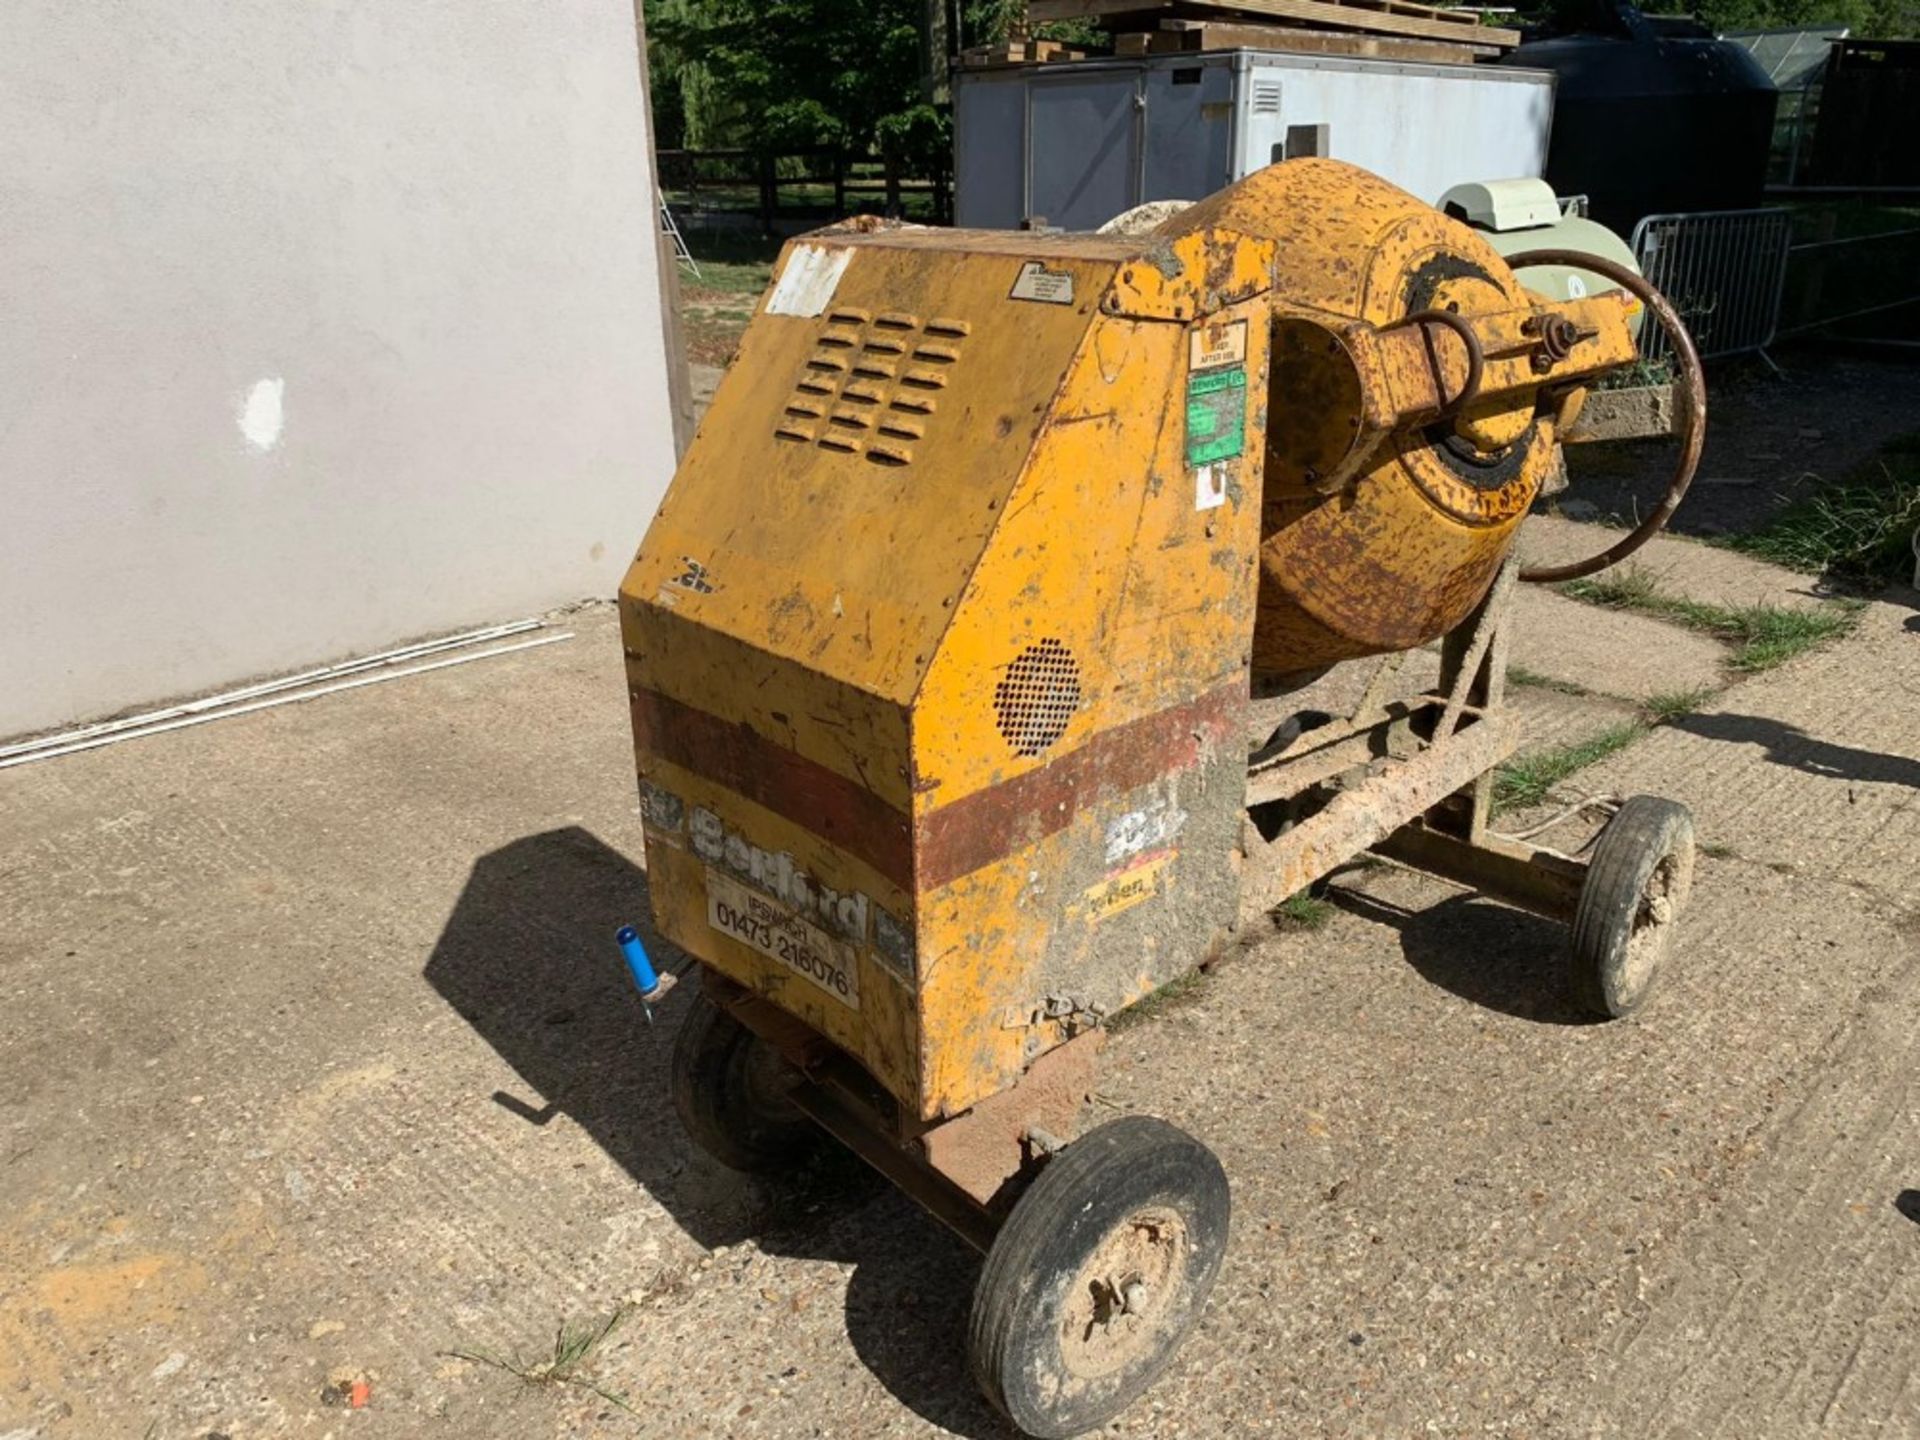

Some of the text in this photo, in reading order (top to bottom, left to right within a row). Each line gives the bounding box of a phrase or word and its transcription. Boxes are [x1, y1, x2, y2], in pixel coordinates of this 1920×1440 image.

[717, 903, 772, 949] 01473
[778, 935, 848, 996] 216076
[748, 895, 807, 942] IPSWICH
